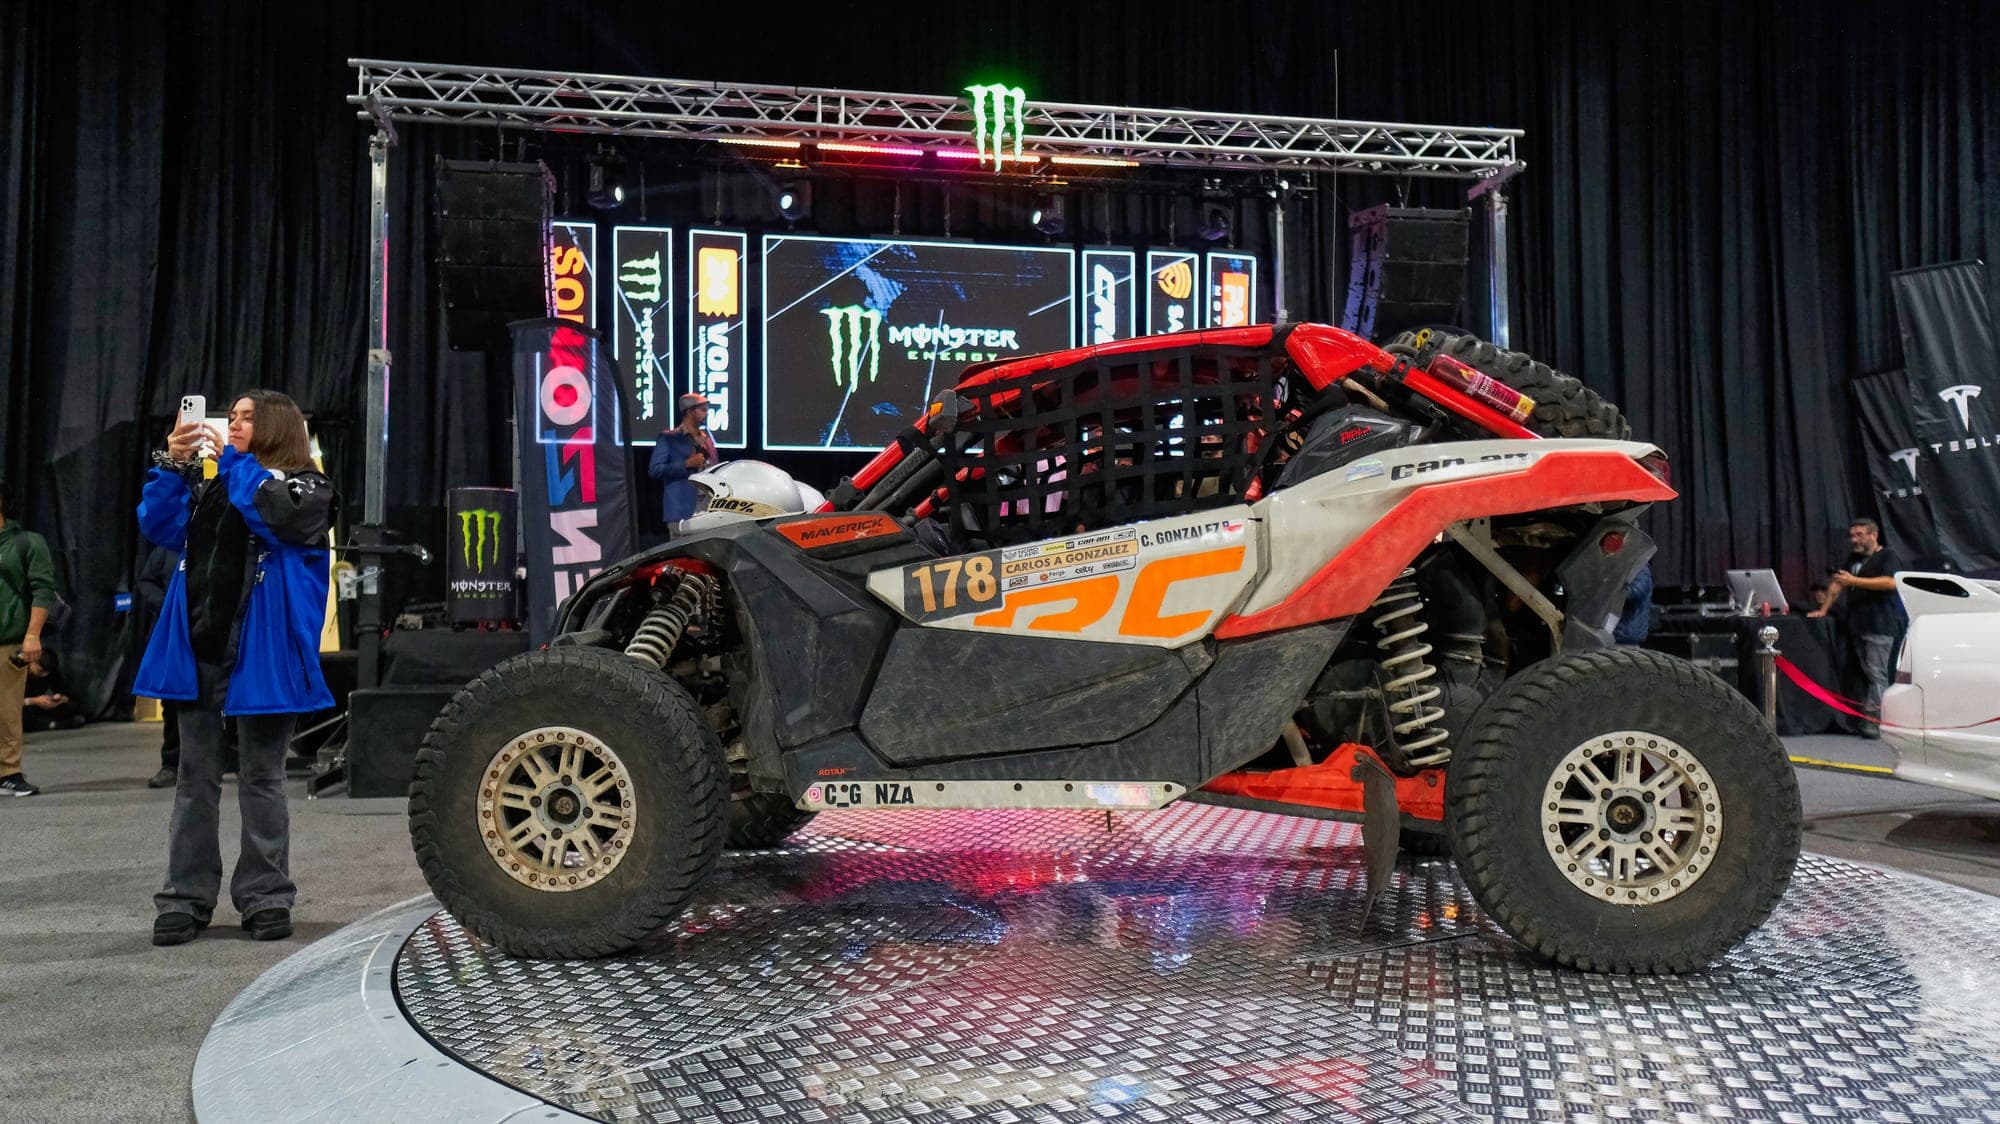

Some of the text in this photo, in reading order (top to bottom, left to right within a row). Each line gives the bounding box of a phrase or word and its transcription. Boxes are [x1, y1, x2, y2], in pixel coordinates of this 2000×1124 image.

[887, 322, 1020, 351] MONSTER
[640, 307, 655, 420] MONSTER
[907, 350, 998, 362] ENERGY
[706, 321, 730, 432] VOLTS
[709, 498, 755, 514] 100%
[800, 517, 884, 541] MAVERICK
[1140, 534, 1154, 547] C.
[1005, 559, 1051, 574] CARLOS
[1053, 556, 1063, 566] A
[1065, 544, 1130, 563] GONZALEZ
[451, 579, 512, 592] MONSTER
[910, 555, 997, 613] 178
[817, 767, 846, 777] ROTAX
